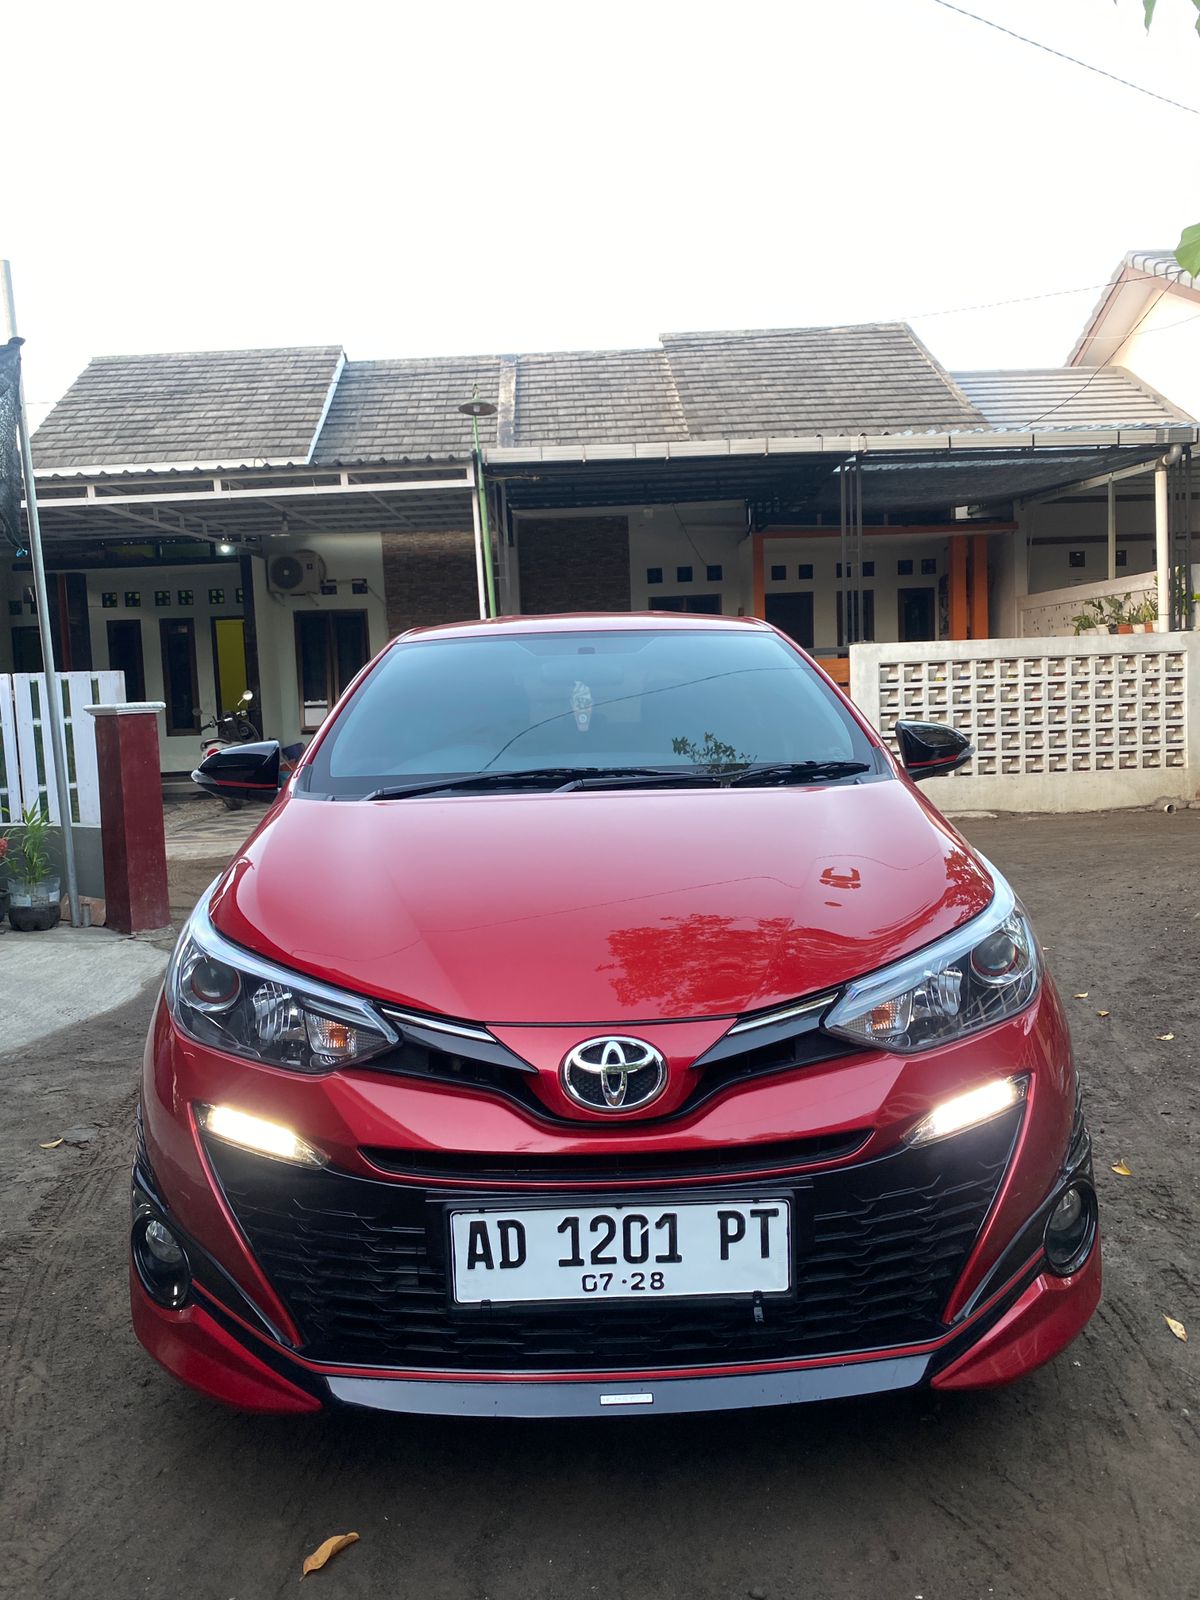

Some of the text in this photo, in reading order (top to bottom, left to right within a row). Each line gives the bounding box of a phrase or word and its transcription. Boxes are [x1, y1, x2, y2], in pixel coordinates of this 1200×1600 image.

[466, 1207, 780, 1271] AD 1201 PT
